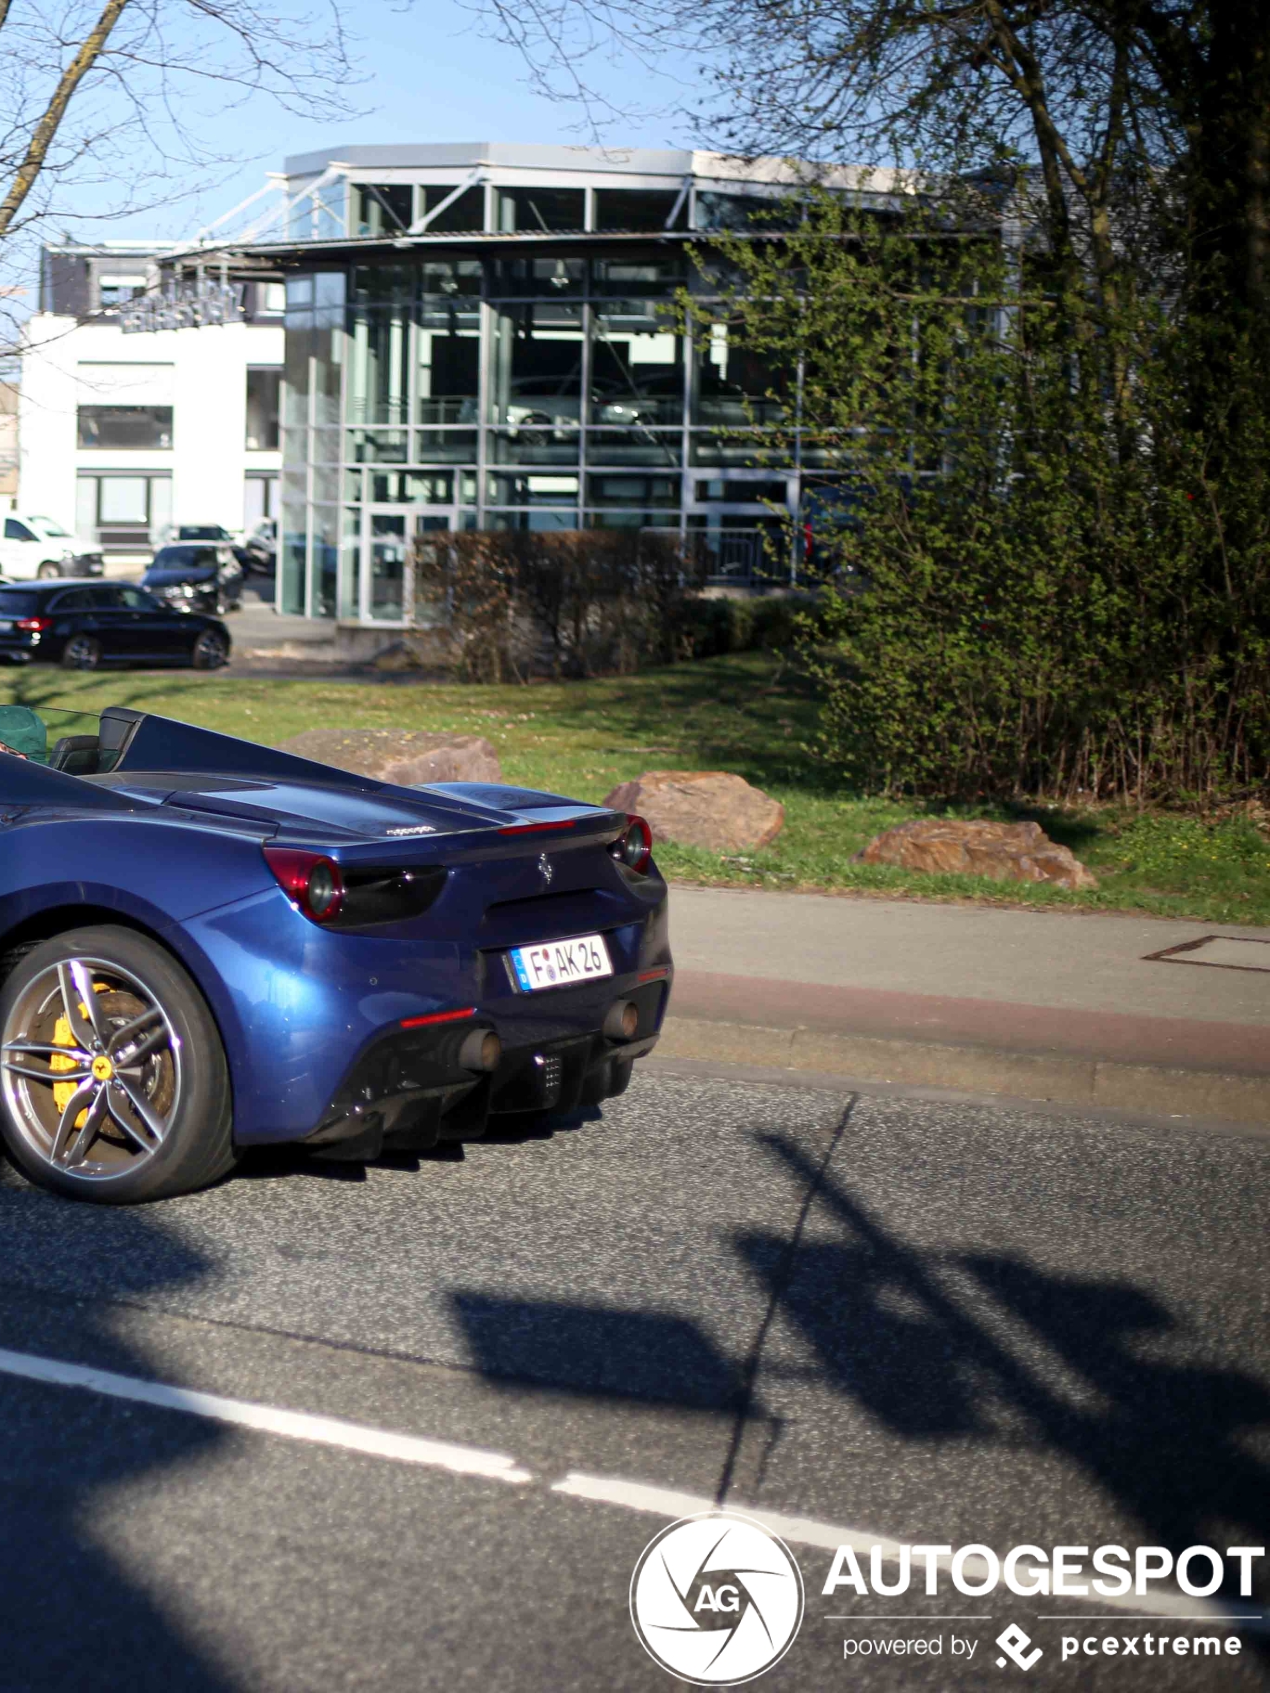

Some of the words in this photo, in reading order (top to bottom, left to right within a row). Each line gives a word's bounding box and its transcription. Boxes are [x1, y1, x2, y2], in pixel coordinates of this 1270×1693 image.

[530, 950, 543, 982] F
[555, 944, 580, 978] AK
[580, 941, 602, 972] 26
